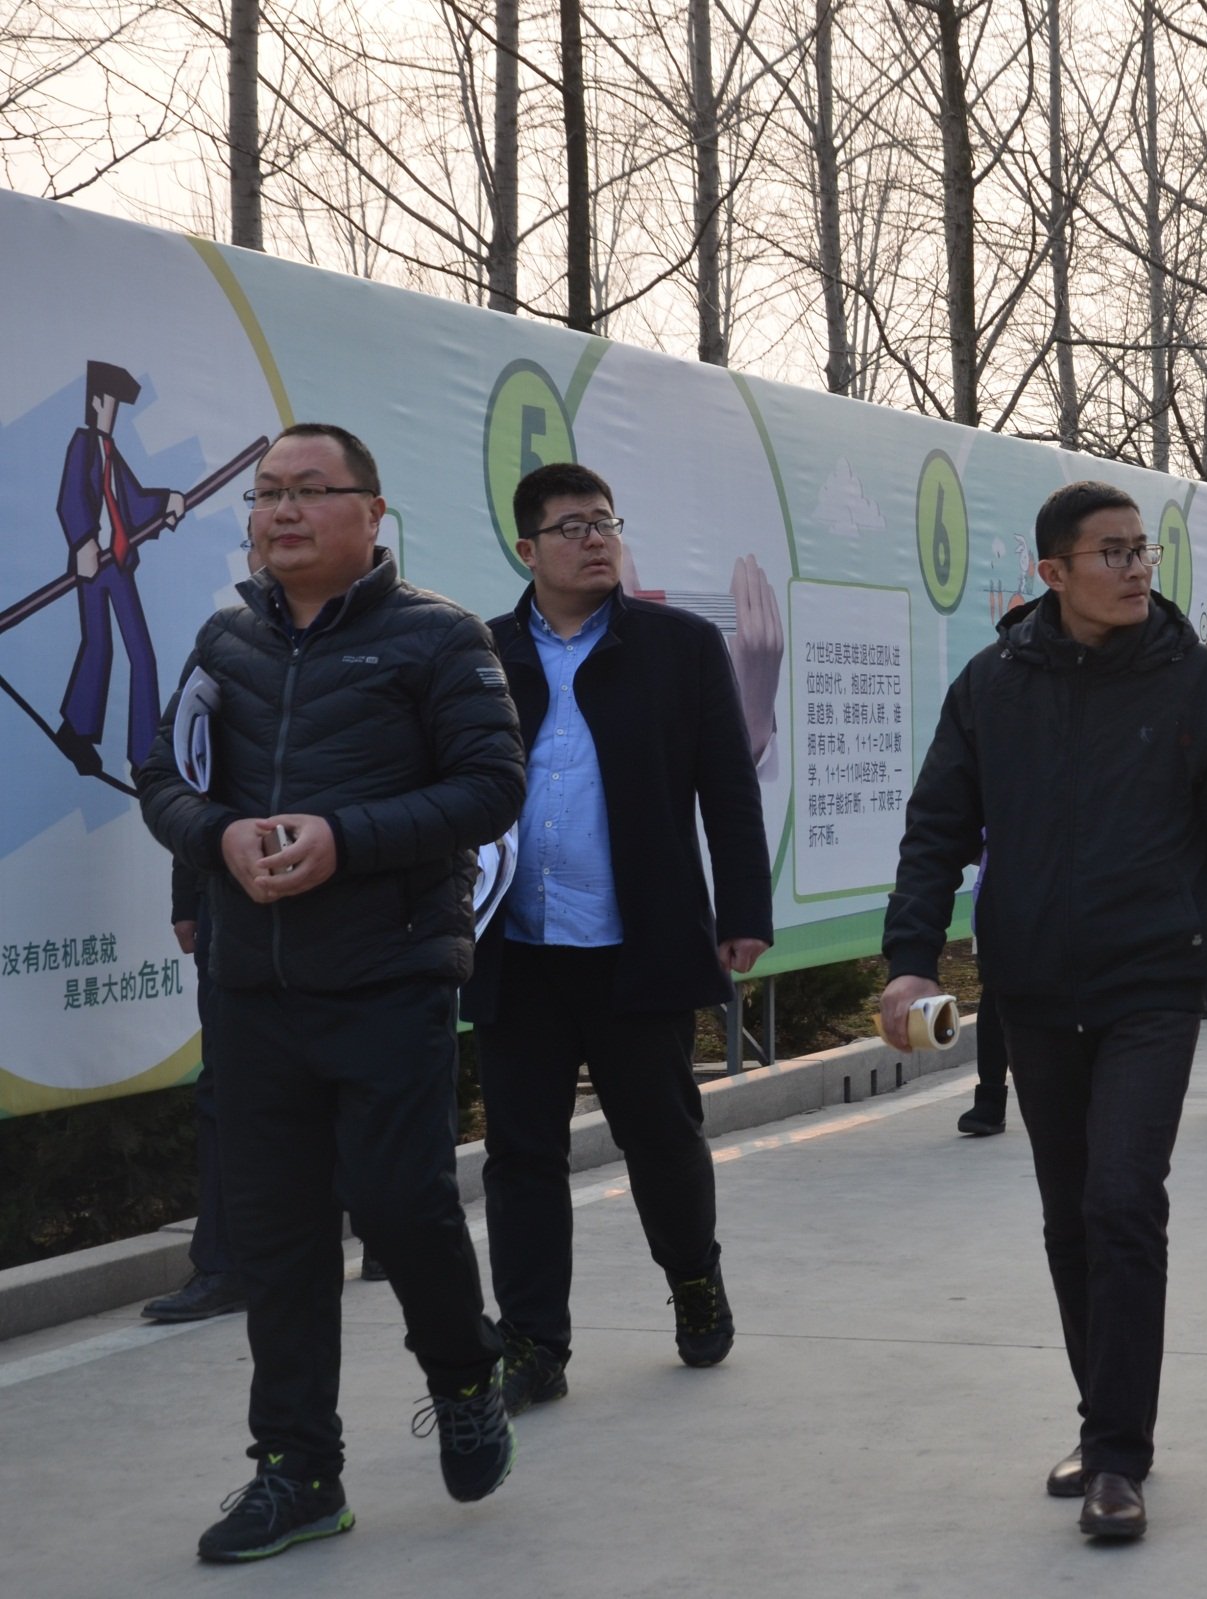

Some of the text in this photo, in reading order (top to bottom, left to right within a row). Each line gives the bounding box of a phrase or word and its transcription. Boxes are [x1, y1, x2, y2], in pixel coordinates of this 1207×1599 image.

[520, 405, 546, 481] 5
[933, 481, 950, 586] 6
[1168, 526, 1180, 603] 7
[1, 932, 118, 976] 没有危机感就
[64, 958, 183, 1010] 是最大的危机
